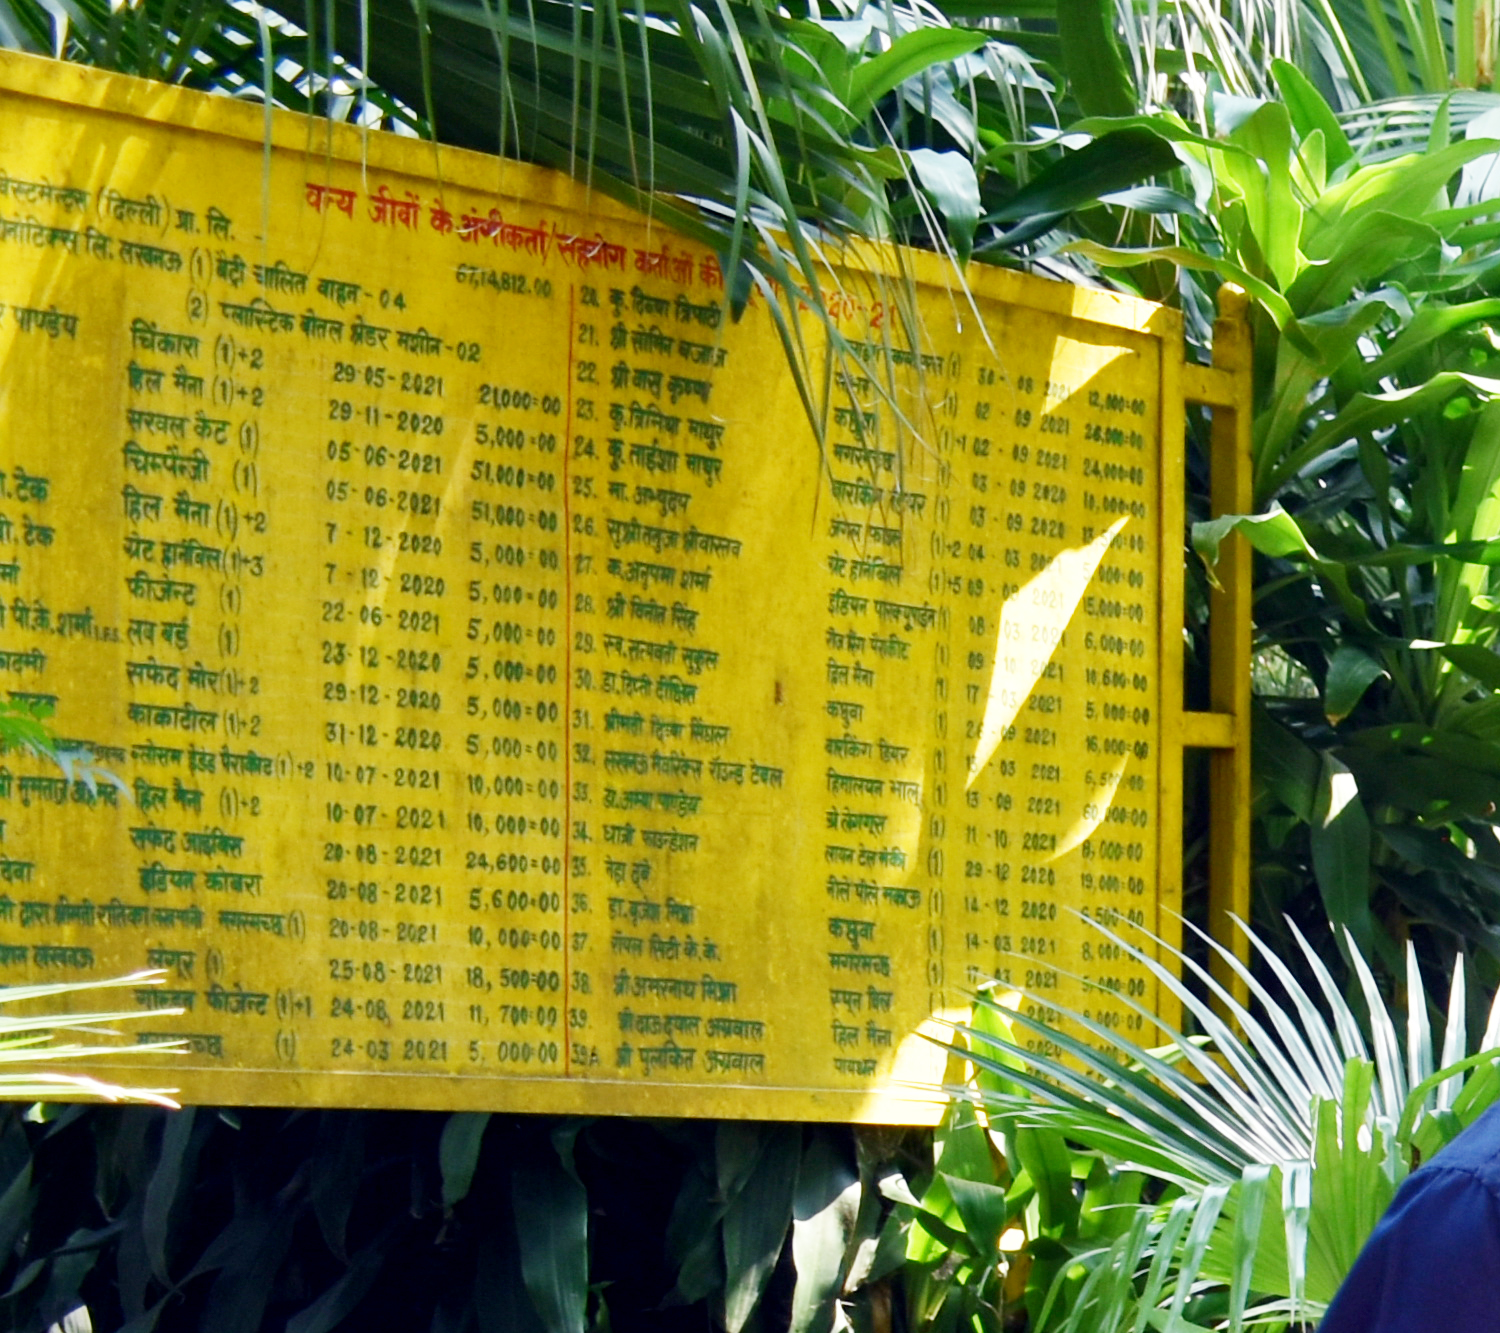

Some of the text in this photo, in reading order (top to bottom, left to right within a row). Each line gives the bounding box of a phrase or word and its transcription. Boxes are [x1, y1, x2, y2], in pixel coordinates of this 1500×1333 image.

[305, 182, 358, 219] वन्य
[429, 196, 454, 235] के
[190, 246, 212, 287] (1)
[186, 287, 209, 327] (2)
[239, 419, 259, 459] (1)
[232, 459, 258, 498] (1)
[219, 583, 242, 615] (1)
[218, 621, 240, 657] (1)
